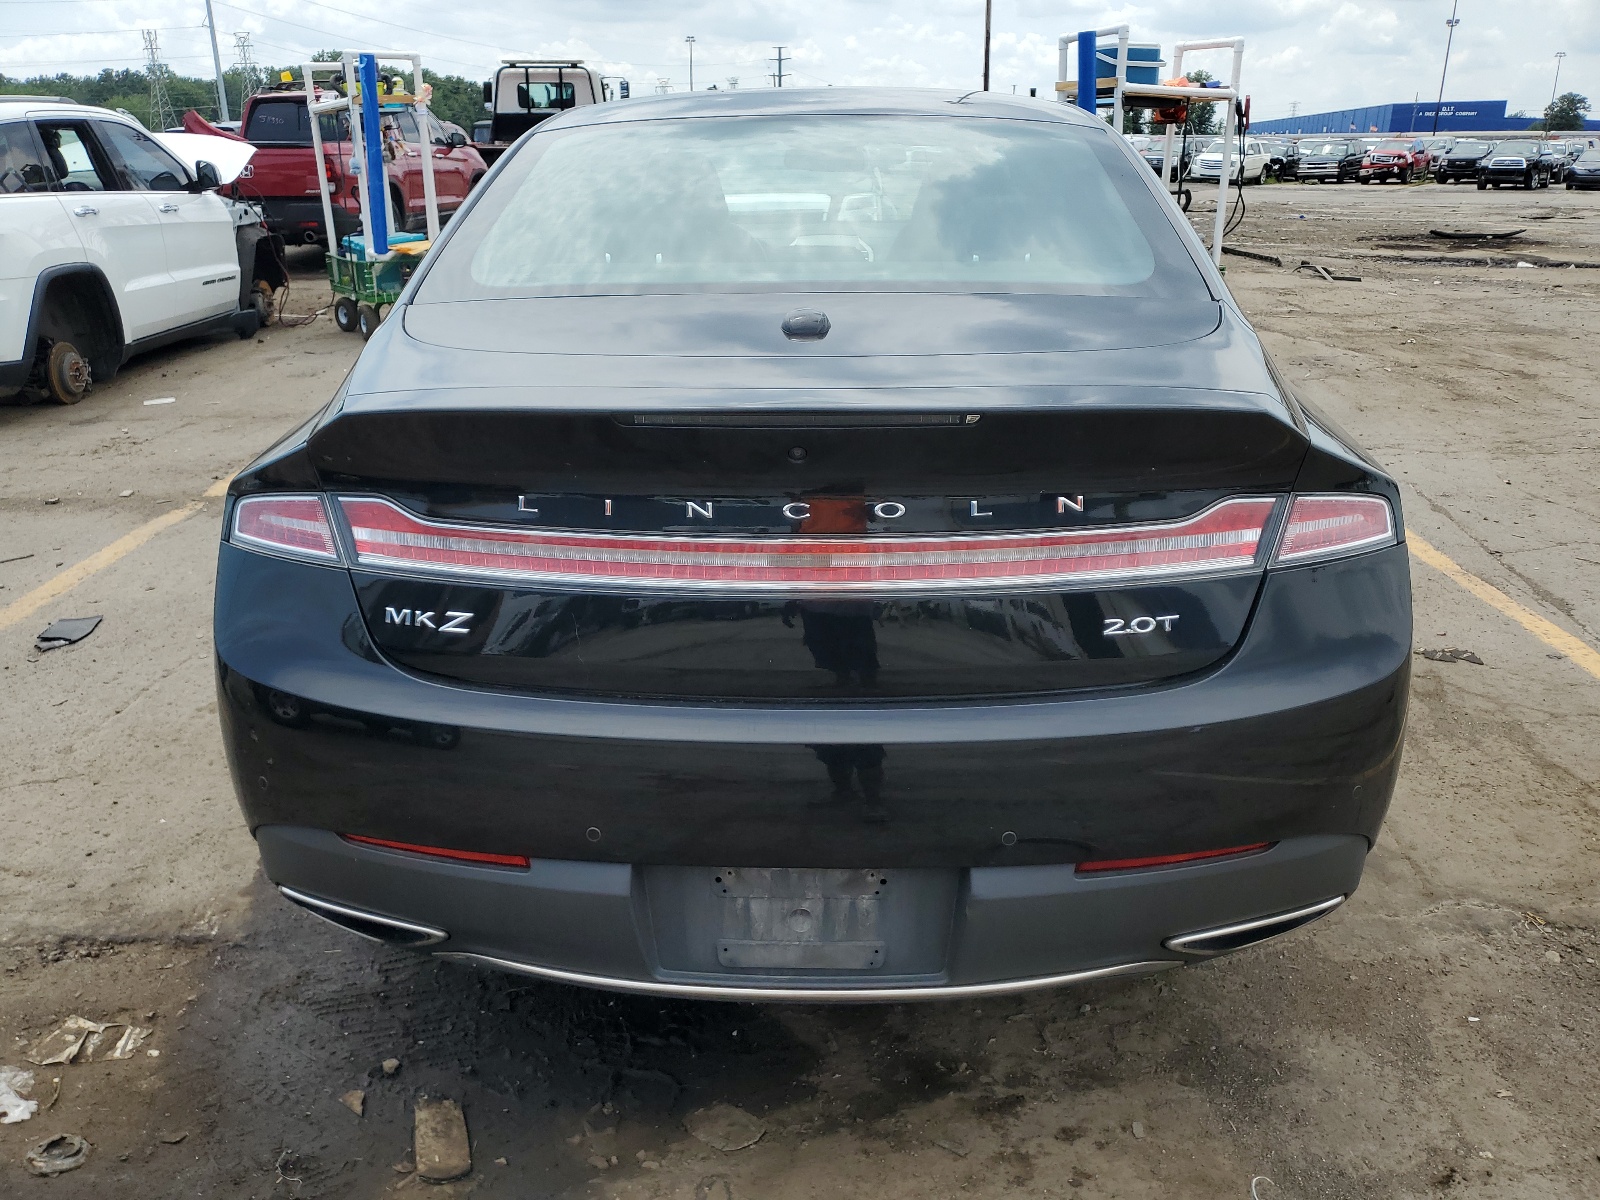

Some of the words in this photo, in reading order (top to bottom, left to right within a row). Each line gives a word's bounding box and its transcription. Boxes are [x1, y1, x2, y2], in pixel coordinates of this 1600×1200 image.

[518, 495, 1084, 520] LINCOLN
[385, 606, 475, 634] MKZ
[1103, 614, 1180, 635] 2.0T
